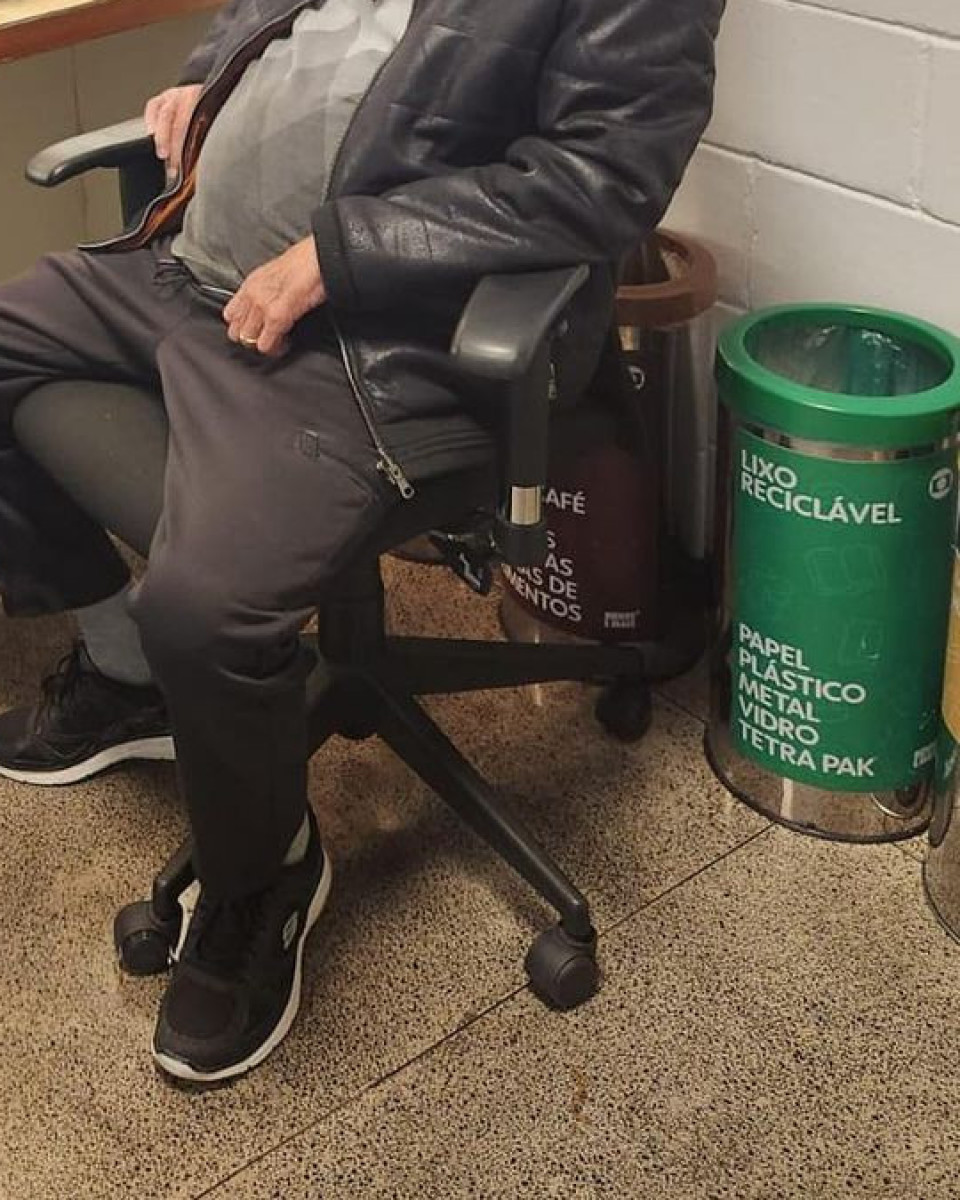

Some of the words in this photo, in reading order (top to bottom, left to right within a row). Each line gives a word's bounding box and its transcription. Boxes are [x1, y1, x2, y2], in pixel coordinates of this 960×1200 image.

[741, 450, 797, 489] LIXO
[542, 487, 586, 514] AFÉ
[741, 471, 902, 524] RECICLÁVEL
[549, 575, 577, 600] DE
[740, 623, 810, 671] PAPEL
[739, 647, 866, 704] PLÁSTICO
[739, 672, 820, 723] METAL
[739, 695, 819, 745] VIDRO
[738, 718, 816, 771] TETRA
[822, 754, 875, 777] PAK
